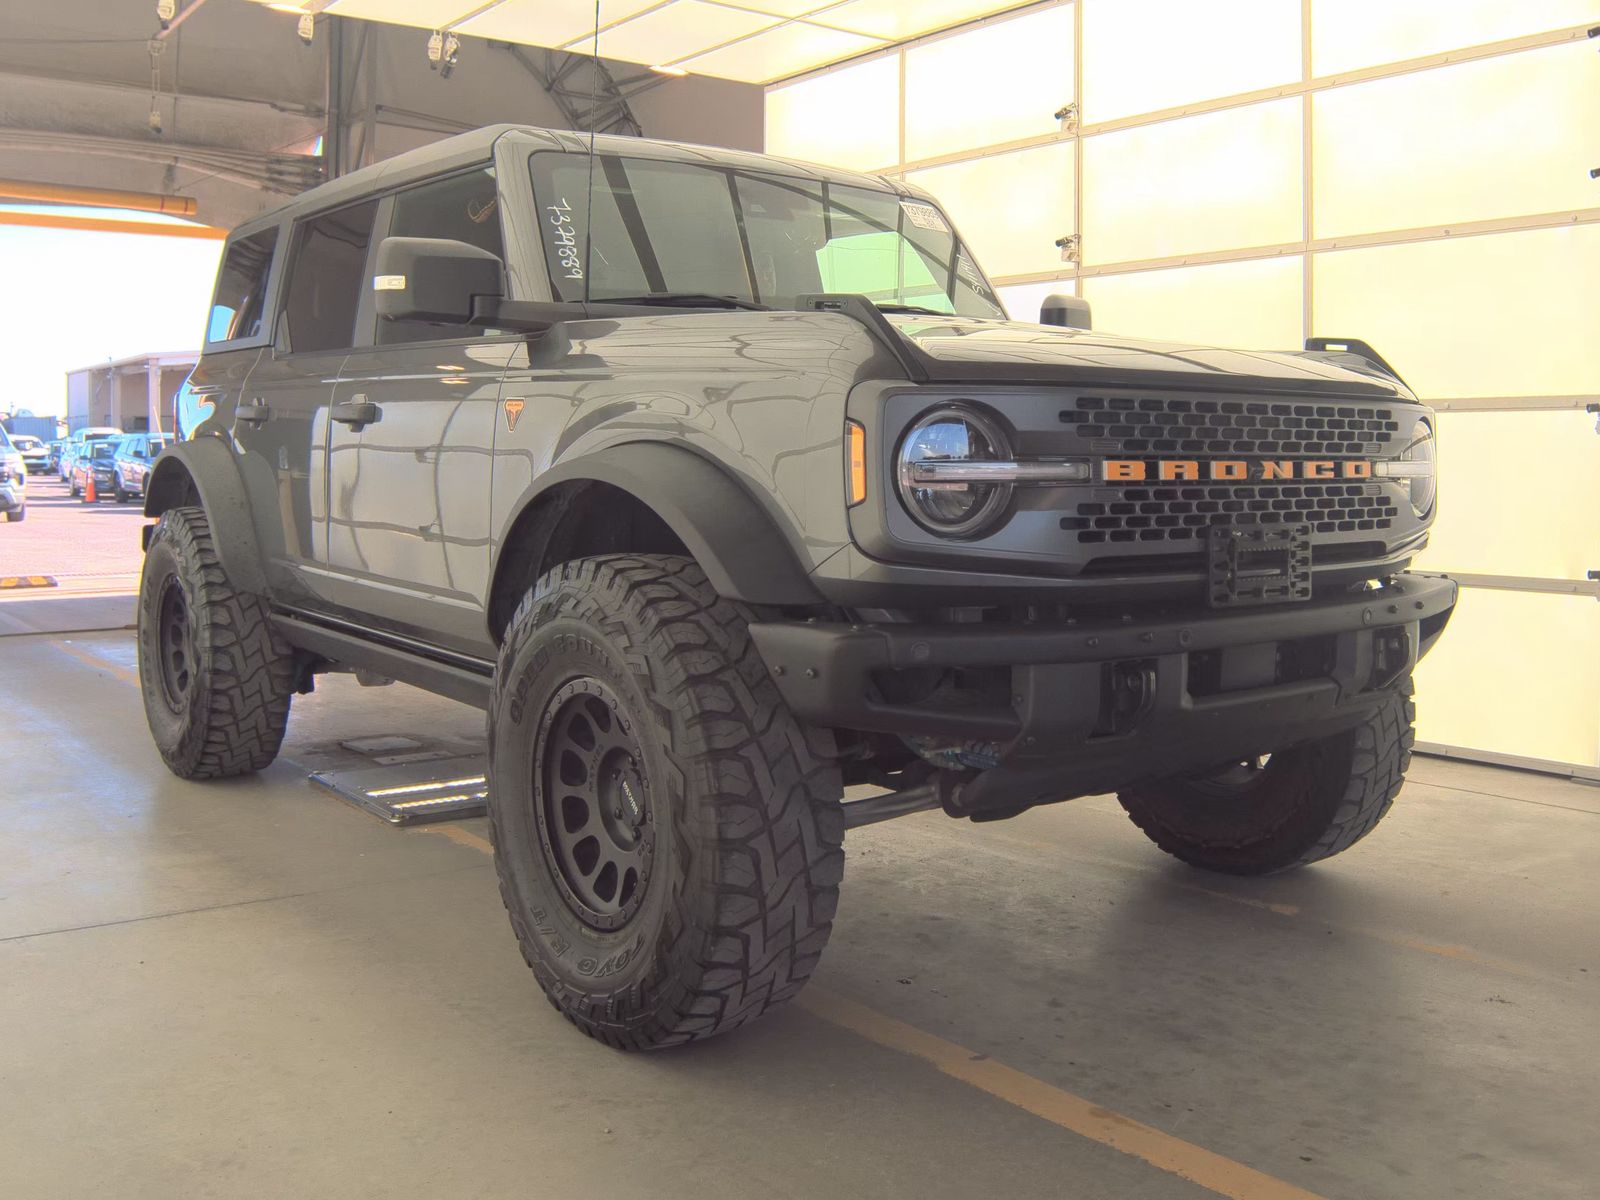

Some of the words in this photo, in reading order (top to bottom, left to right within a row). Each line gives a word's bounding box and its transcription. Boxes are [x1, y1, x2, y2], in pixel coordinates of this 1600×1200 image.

[546, 197, 583, 279] 7379889
[1102, 459, 1372, 481] BRONCO
[576, 933, 645, 978] TOYO
